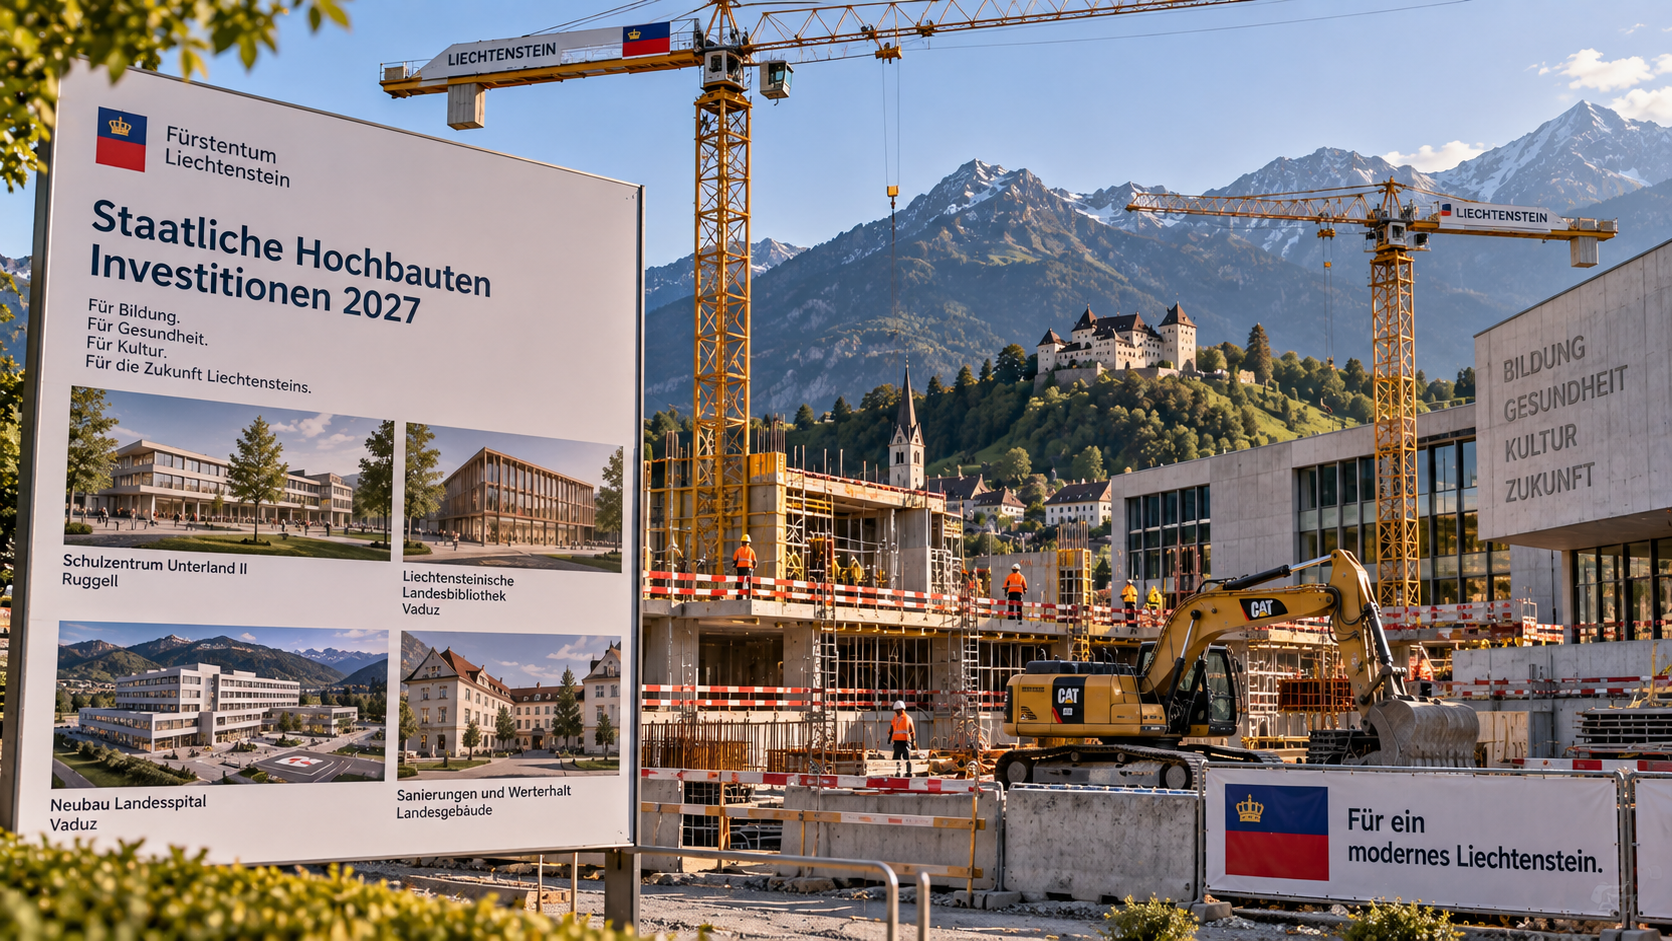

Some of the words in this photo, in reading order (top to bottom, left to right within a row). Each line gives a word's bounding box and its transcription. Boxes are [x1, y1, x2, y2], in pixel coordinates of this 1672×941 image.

[448, 42, 556, 67] LIECHTENSTEIN
[167, 126, 277, 163] Fürstentum
[166, 148, 290, 188] Liechtenstein
[1456, 207, 1548, 223] LIECHTENSTEIN
[92, 200, 283, 262] Staatliche
[297, 236, 491, 298] Hochbauten
[91, 244, 330, 312] Investitionen
[343, 287, 421, 324] 2027
[88, 298, 114, 314] Für
[119, 303, 181, 326] Bildung.
[88, 317, 113, 332] Für
[118, 321, 208, 347] Gesundheit.
[87, 335, 113, 351] Für
[118, 340, 167, 359] Kultur.
[1503, 335, 1585, 383] BILDUNG
[86, 354, 112, 370] Für
[116, 358, 139, 373] die
[144, 362, 203, 381] Zukunft
[207, 369, 311, 394] Liechtensteins.
[1504, 364, 1628, 422] GESUNDHEIT
[1505, 423, 1577, 462] KULTUR
[1505, 461, 1595, 503] ZUKUNFT
[63, 554, 163, 571] Schulzentrum
[168, 559, 236, 574] Unterland
[240, 563, 247, 574] II
[62, 572, 118, 589] Ruggell
[403, 571, 514, 587] Liechtensteinische
[403, 586, 506, 602] Landesbibliothek
[402, 603, 440, 616] Vaduz
[1251, 600, 1273, 618] CAT
[1058, 688, 1079, 704] CAT
[50, 797, 109, 812] Neubau
[115, 794, 206, 811] Landesspital
[397, 788, 477, 803] Sanierungen
[481, 786, 505, 799] und
[508, 784, 572, 798] Werterhalt
[50, 817, 97, 831] Vaduz
[1348, 808, 1384, 832] Für
[1391, 809, 1425, 834] ein
[1348, 841, 1450, 867] modernes
[1457, 844, 1603, 874] Liechtenstein.
